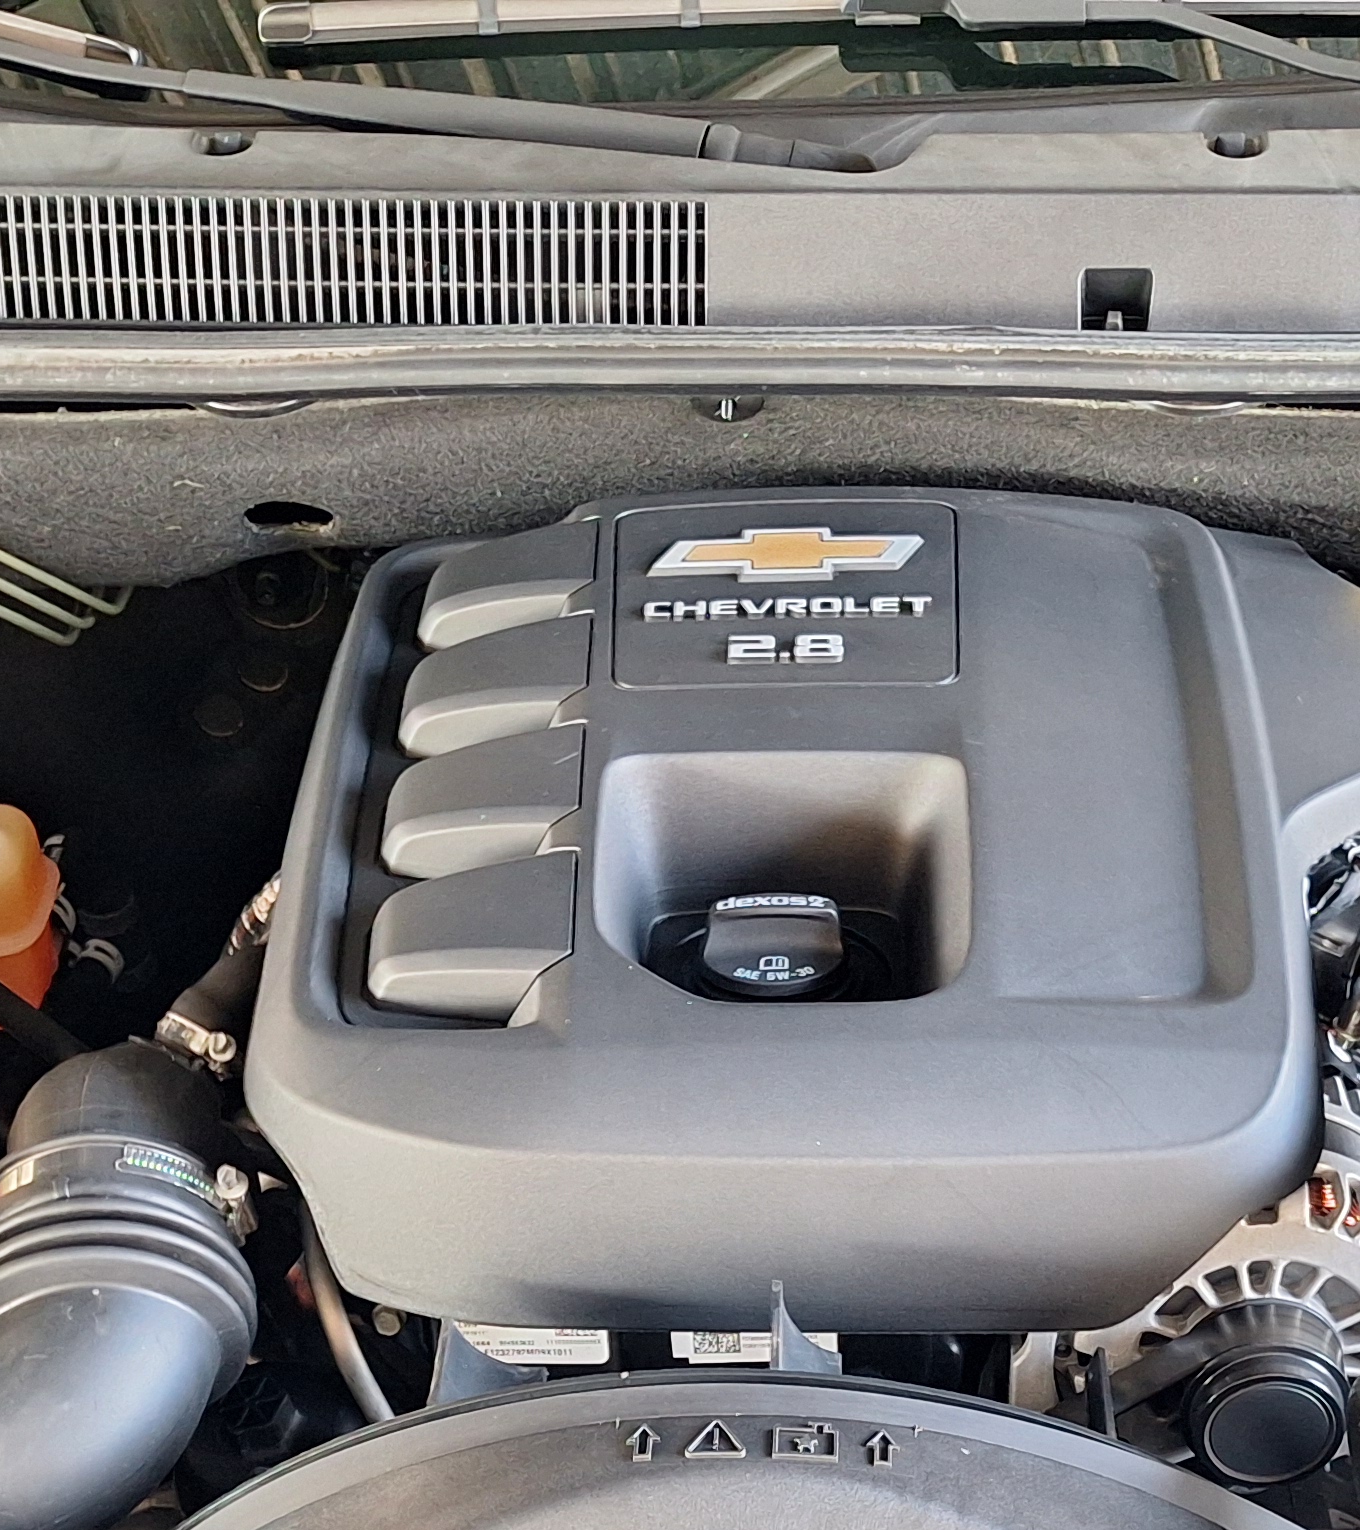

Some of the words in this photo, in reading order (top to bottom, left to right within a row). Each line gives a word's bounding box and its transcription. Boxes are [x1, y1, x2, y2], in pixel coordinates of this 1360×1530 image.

[643, 596, 932, 622] CHEVROLET
[727, 634, 845, 664] 2.8
[733, 967, 761, 981] SAE
